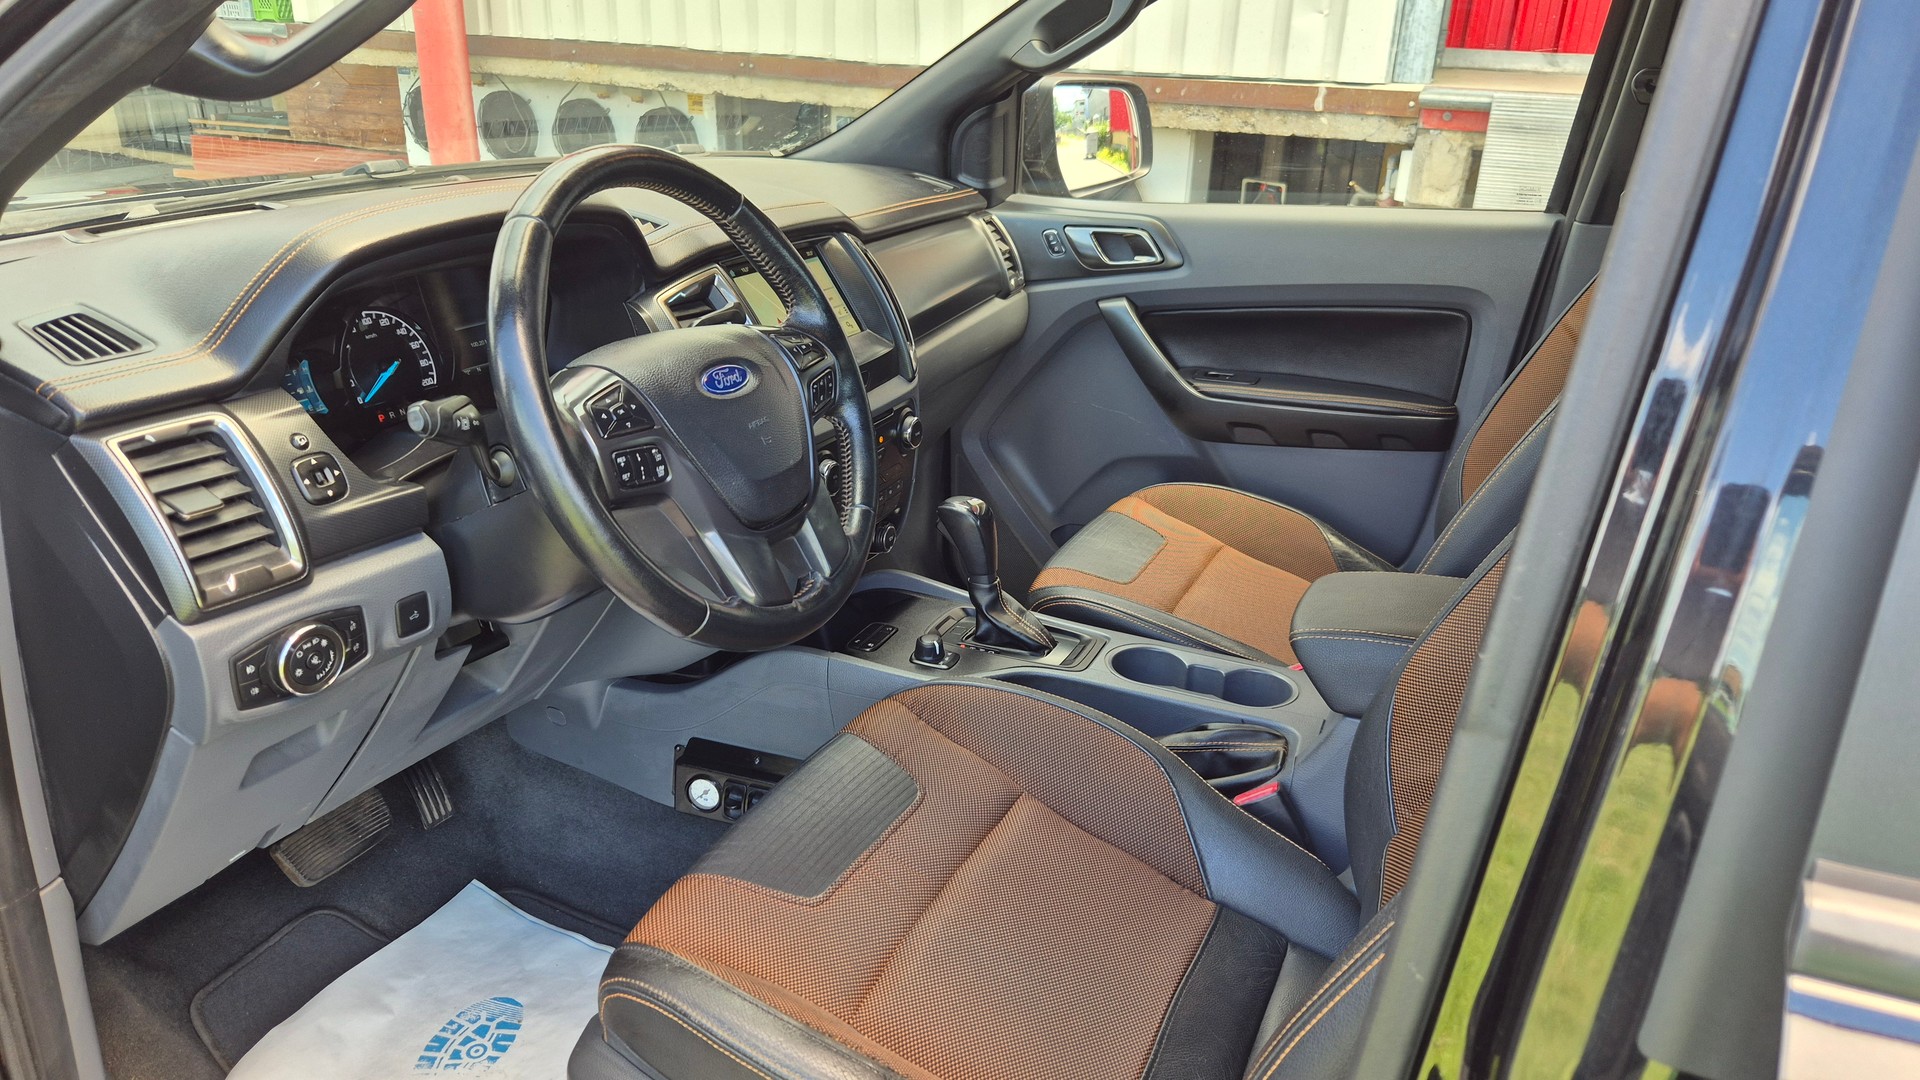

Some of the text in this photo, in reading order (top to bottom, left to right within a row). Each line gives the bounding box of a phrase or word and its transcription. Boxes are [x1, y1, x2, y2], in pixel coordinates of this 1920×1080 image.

[379, 317, 390, 327] 120
[396, 327, 408, 336] 140
[409, 340, 421, 350] 160
[421, 377, 434, 387] 200
[712, 367, 743, 389] Ford
[378, 408, 406, 423] P R N
